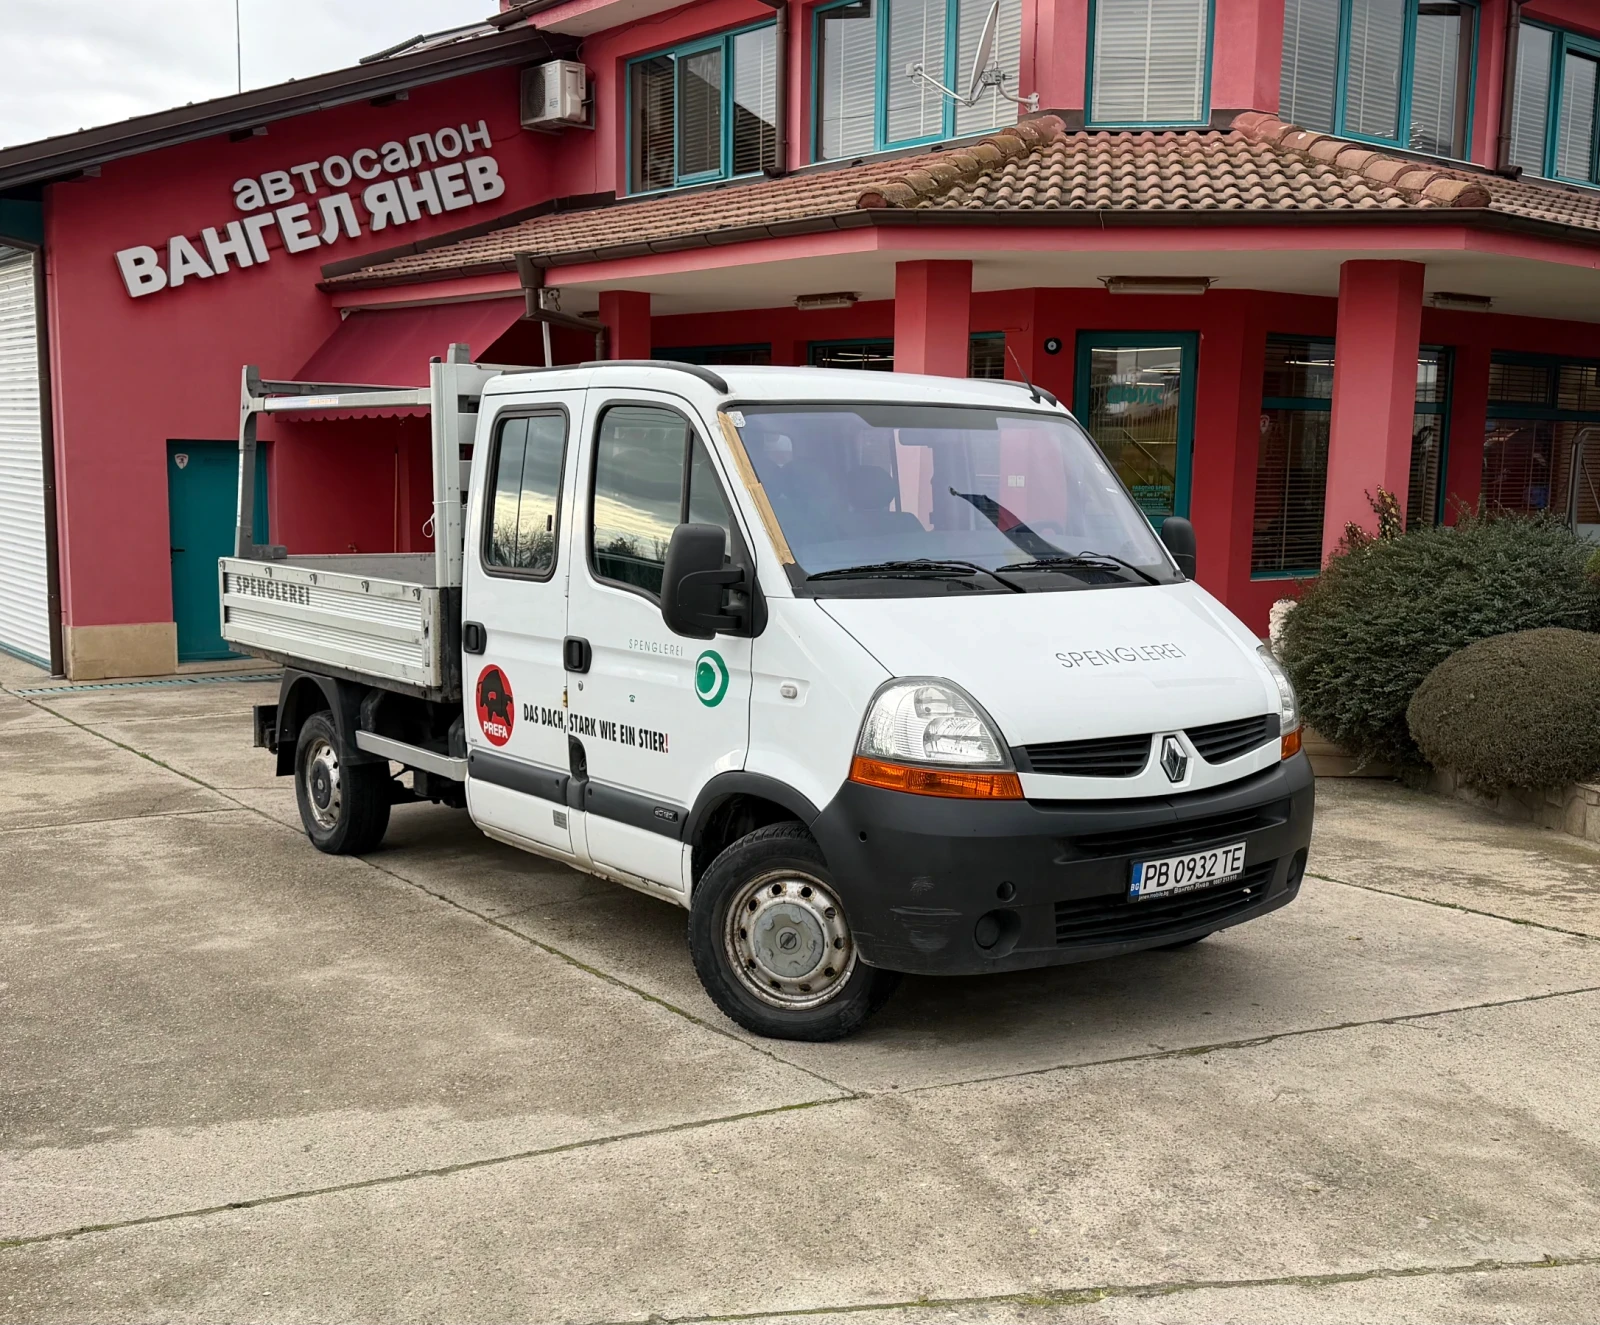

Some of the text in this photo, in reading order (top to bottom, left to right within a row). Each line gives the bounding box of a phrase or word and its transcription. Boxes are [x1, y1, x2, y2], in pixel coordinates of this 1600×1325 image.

[232, 119, 492, 211] автосалон
[114, 155, 505, 298] ВАНГЕЛ ЯНЕВ
[236, 576, 310, 605] SPENGLEREI
[629, 639, 683, 656] SPENGLEREI
[1055, 643, 1187, 668] SPENGLEREI
[483, 720, 509, 739] PREFA
[523, 703, 669, 753] DAS DACH, STARK WIE EIN STIER!
[1143, 847, 1243, 890] PB 0932 TE
[1130, 882, 1140, 891] BG
